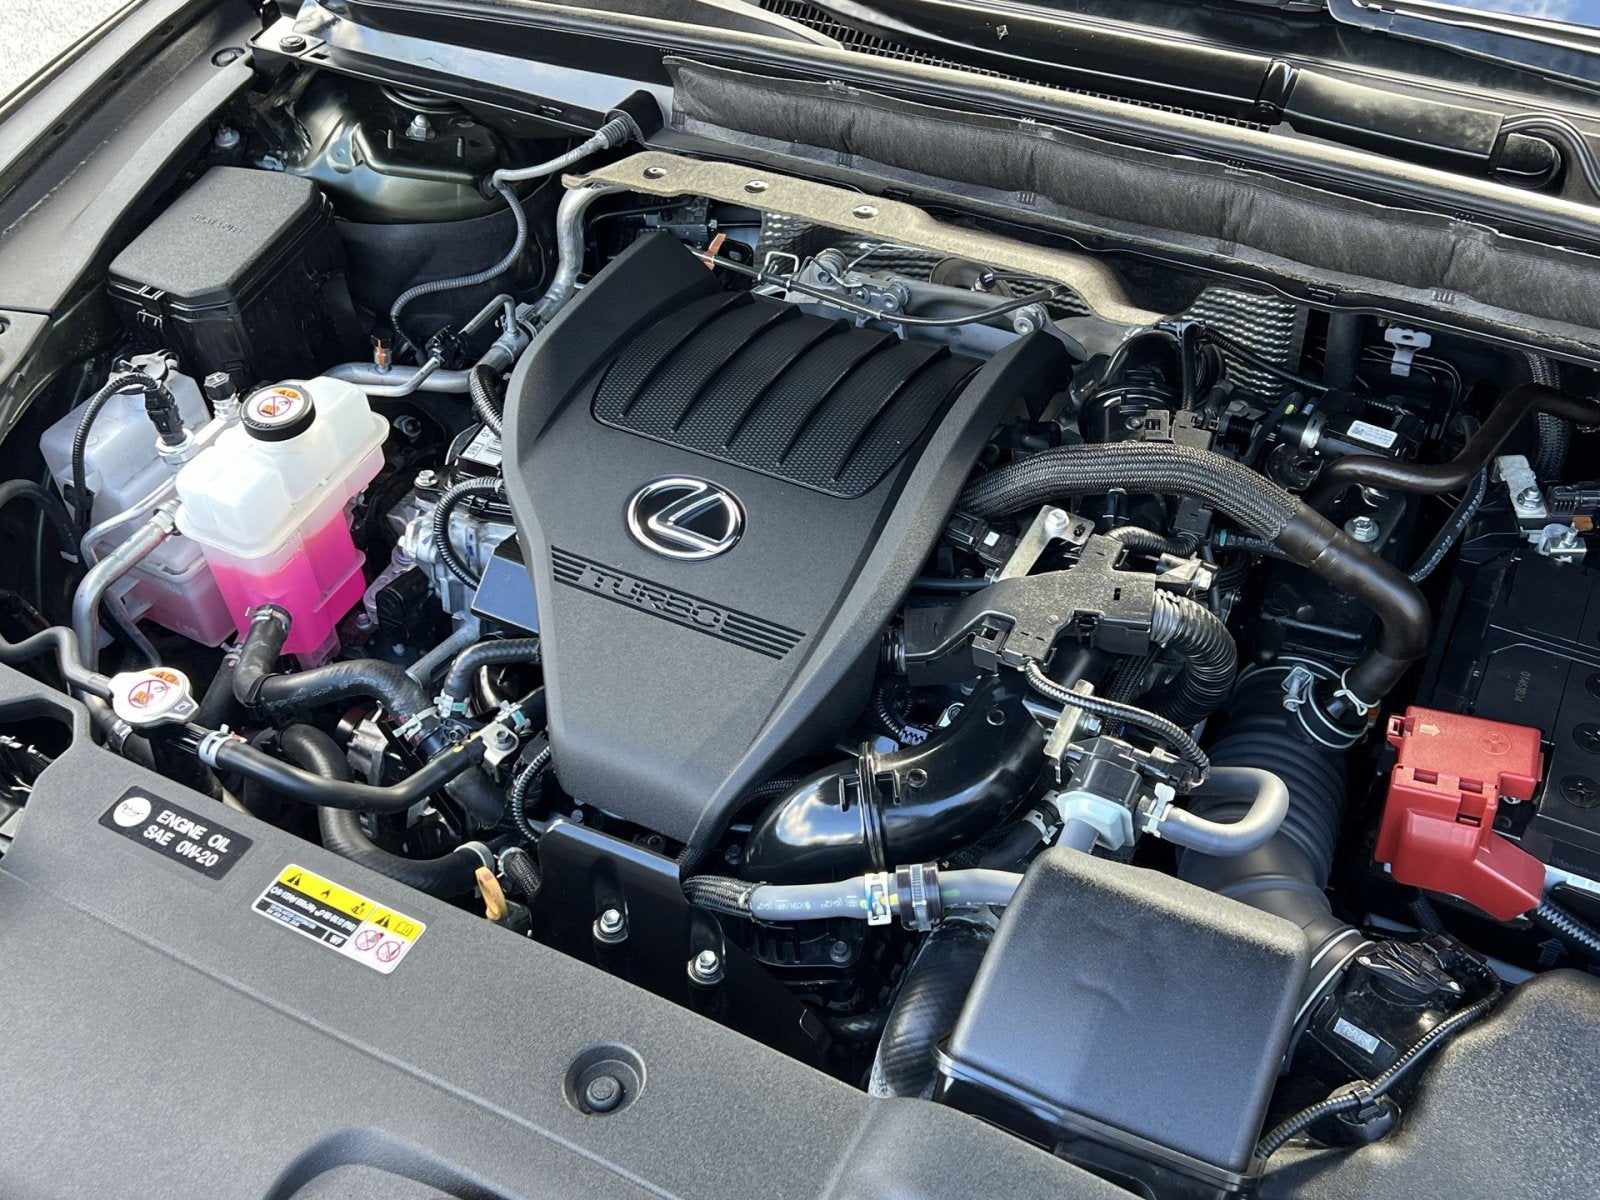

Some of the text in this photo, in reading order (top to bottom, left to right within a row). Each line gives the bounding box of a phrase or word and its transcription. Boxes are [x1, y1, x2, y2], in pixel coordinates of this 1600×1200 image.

[588, 567, 722, 627] TURBO
[143, 824, 219, 867] SAE 0W-20
[156, 809, 231, 853] ENGINE OIL
